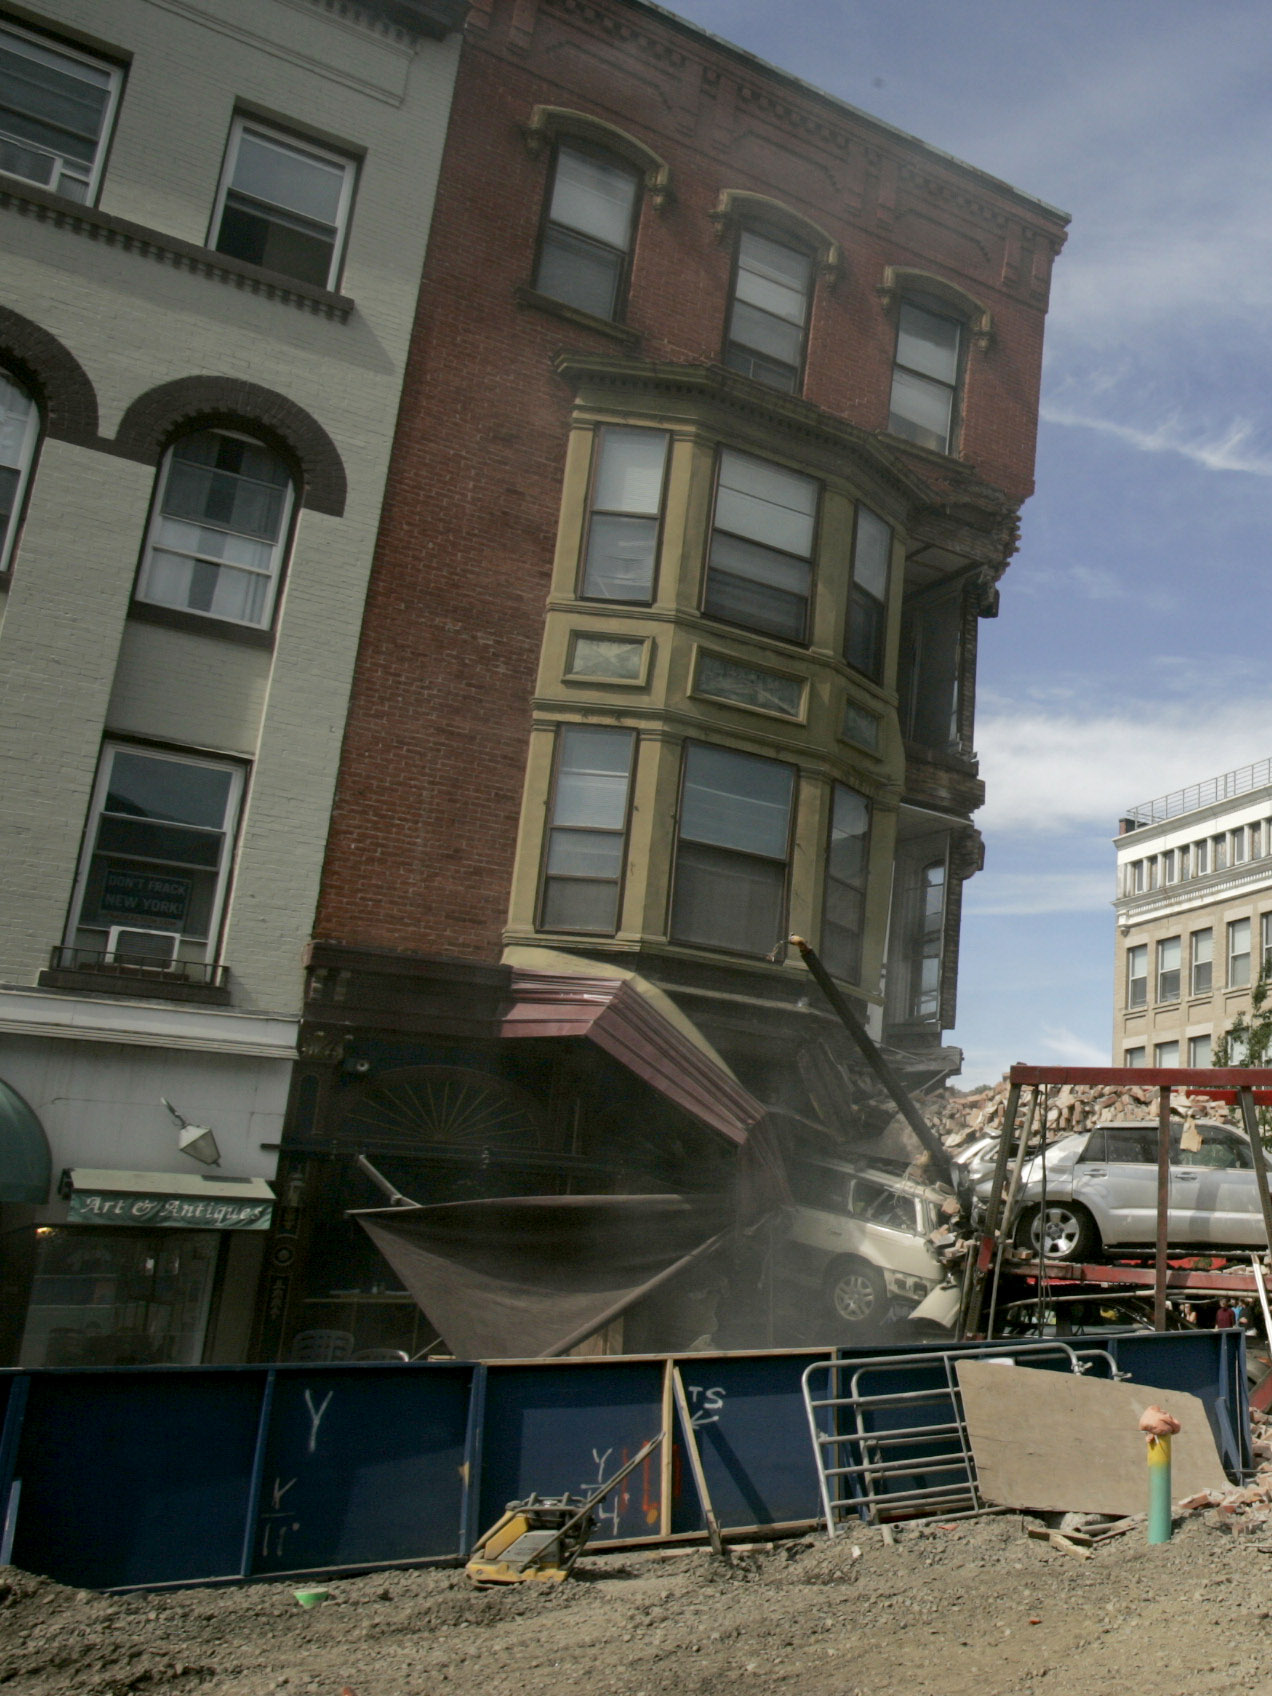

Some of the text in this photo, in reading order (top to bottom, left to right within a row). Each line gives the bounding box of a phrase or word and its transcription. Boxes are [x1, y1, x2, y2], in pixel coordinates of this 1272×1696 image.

[148, 880, 186, 897] FRACK
[105, 893, 138, 908] NEW
[80, 1196, 264, 1226] Art & Antiques
